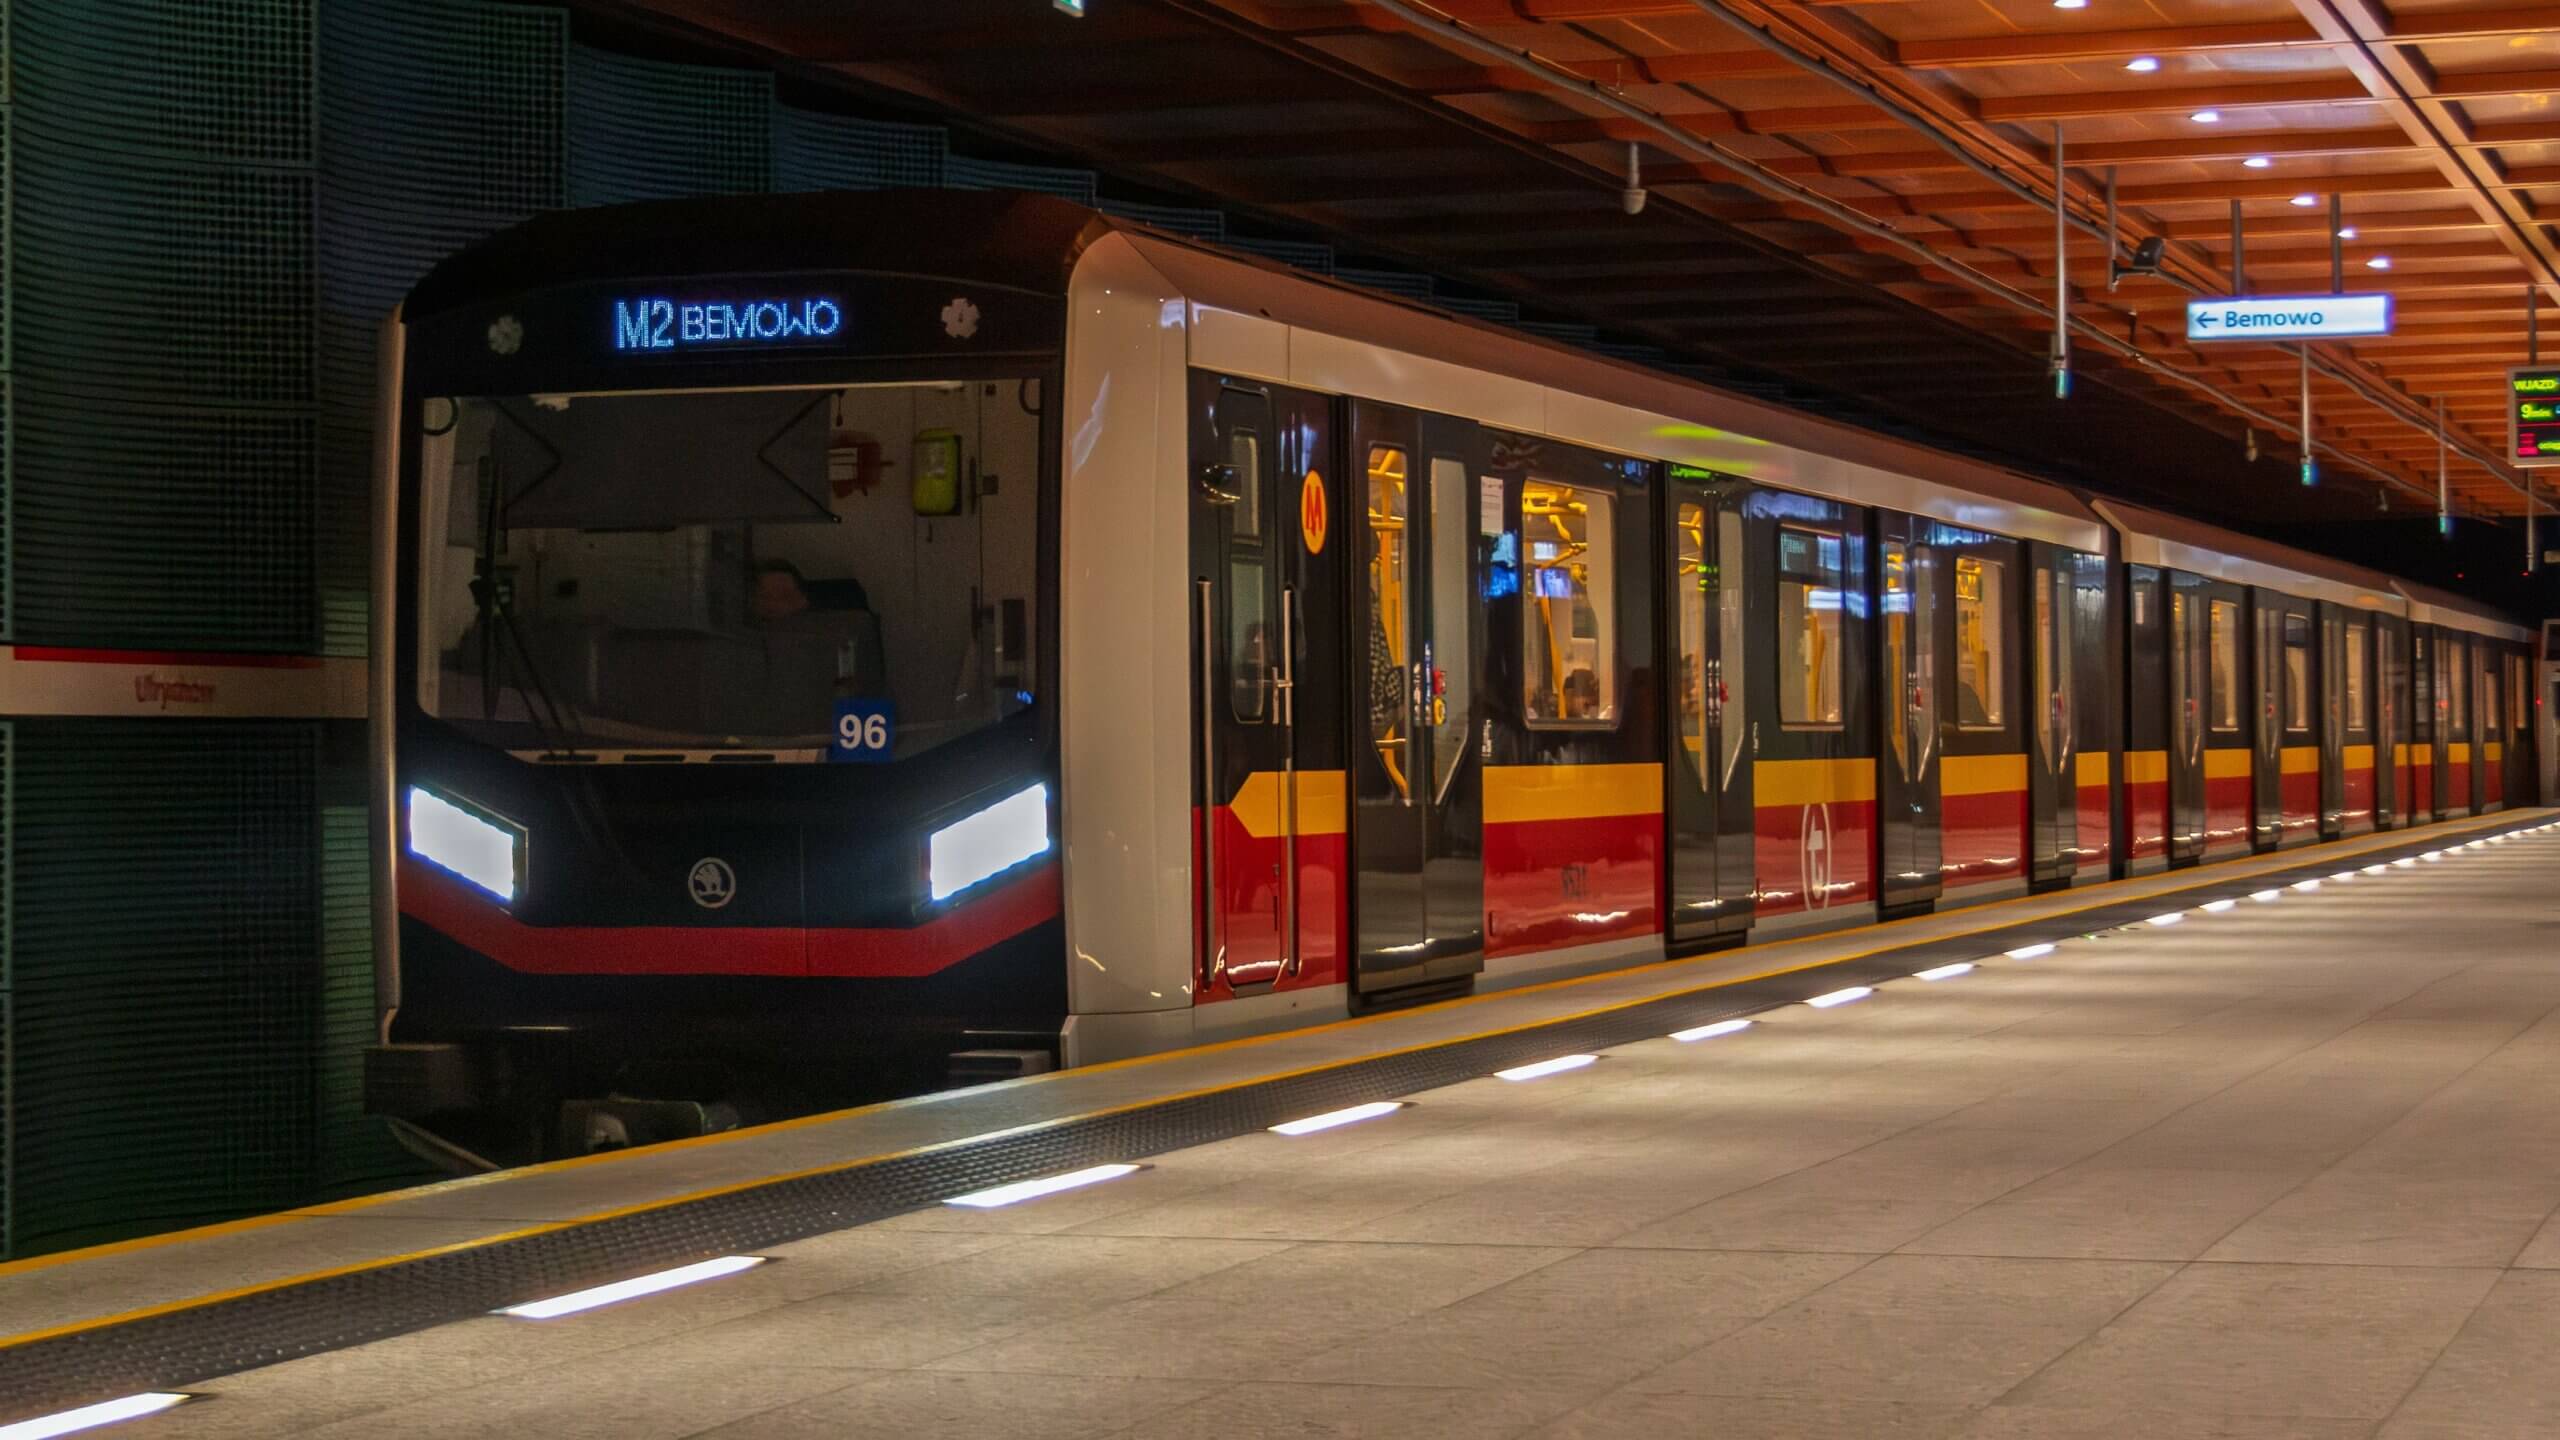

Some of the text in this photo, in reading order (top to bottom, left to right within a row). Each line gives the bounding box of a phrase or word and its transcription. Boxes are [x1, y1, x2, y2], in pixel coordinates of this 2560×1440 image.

[616, 299, 839, 348] M2 BEMOWO
[2225, 311, 2323, 328] Bemowo
[839, 713, 887, 750] 96
